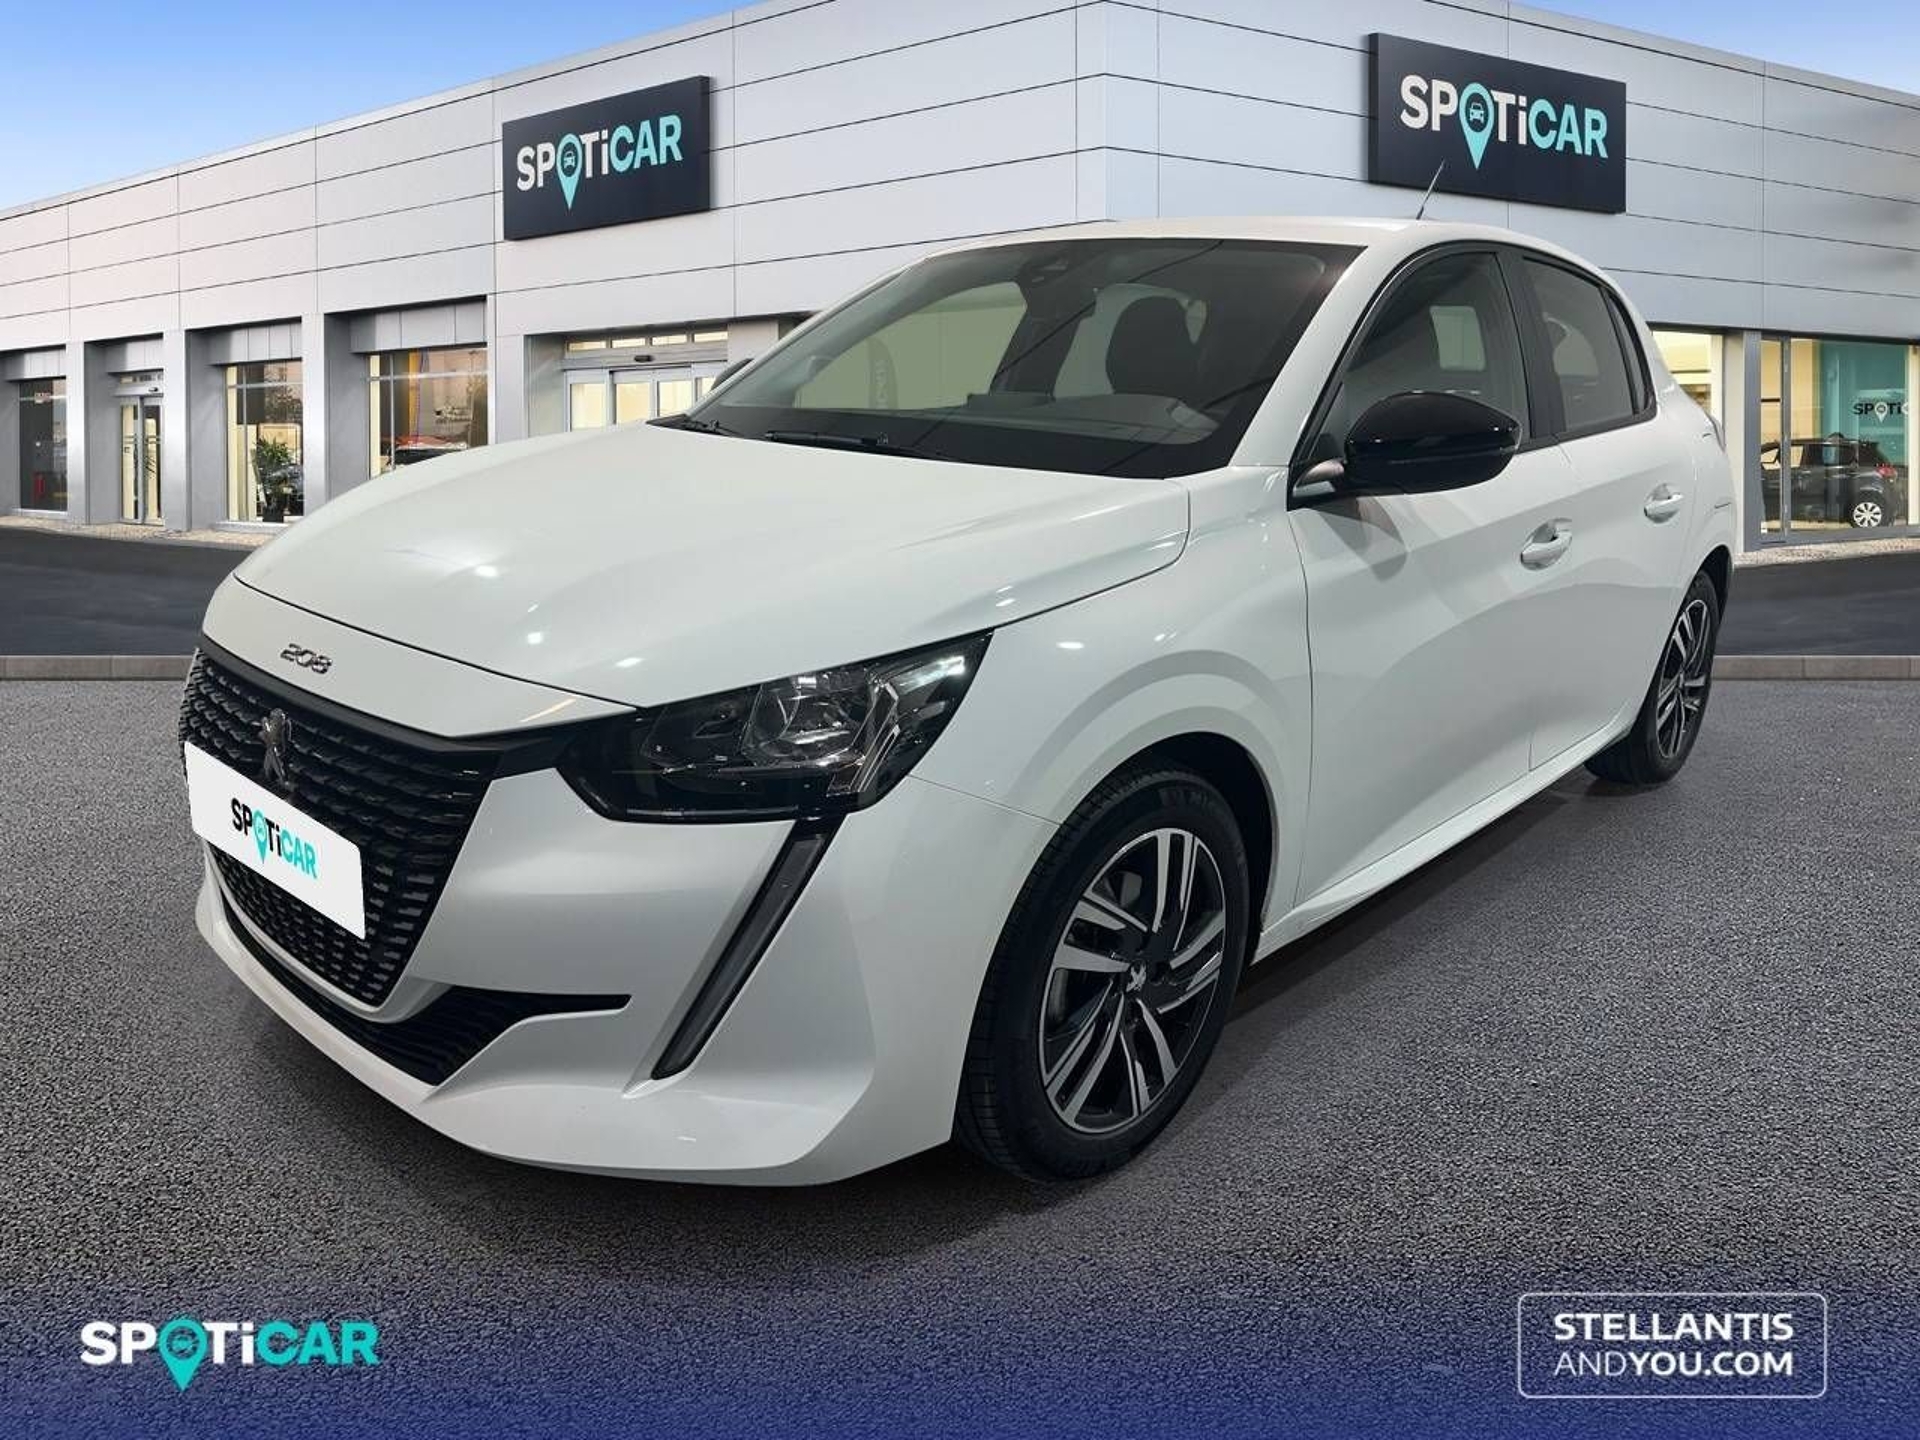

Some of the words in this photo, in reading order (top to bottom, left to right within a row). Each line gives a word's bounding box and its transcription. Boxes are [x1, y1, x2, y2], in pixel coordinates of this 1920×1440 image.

[516, 114, 683, 210] SPOTiCAR
[1400, 74, 1608, 169] SPOTiCAR
[280, 643, 332, 674] 208
[231, 797, 317, 879] SPOTiCAR
